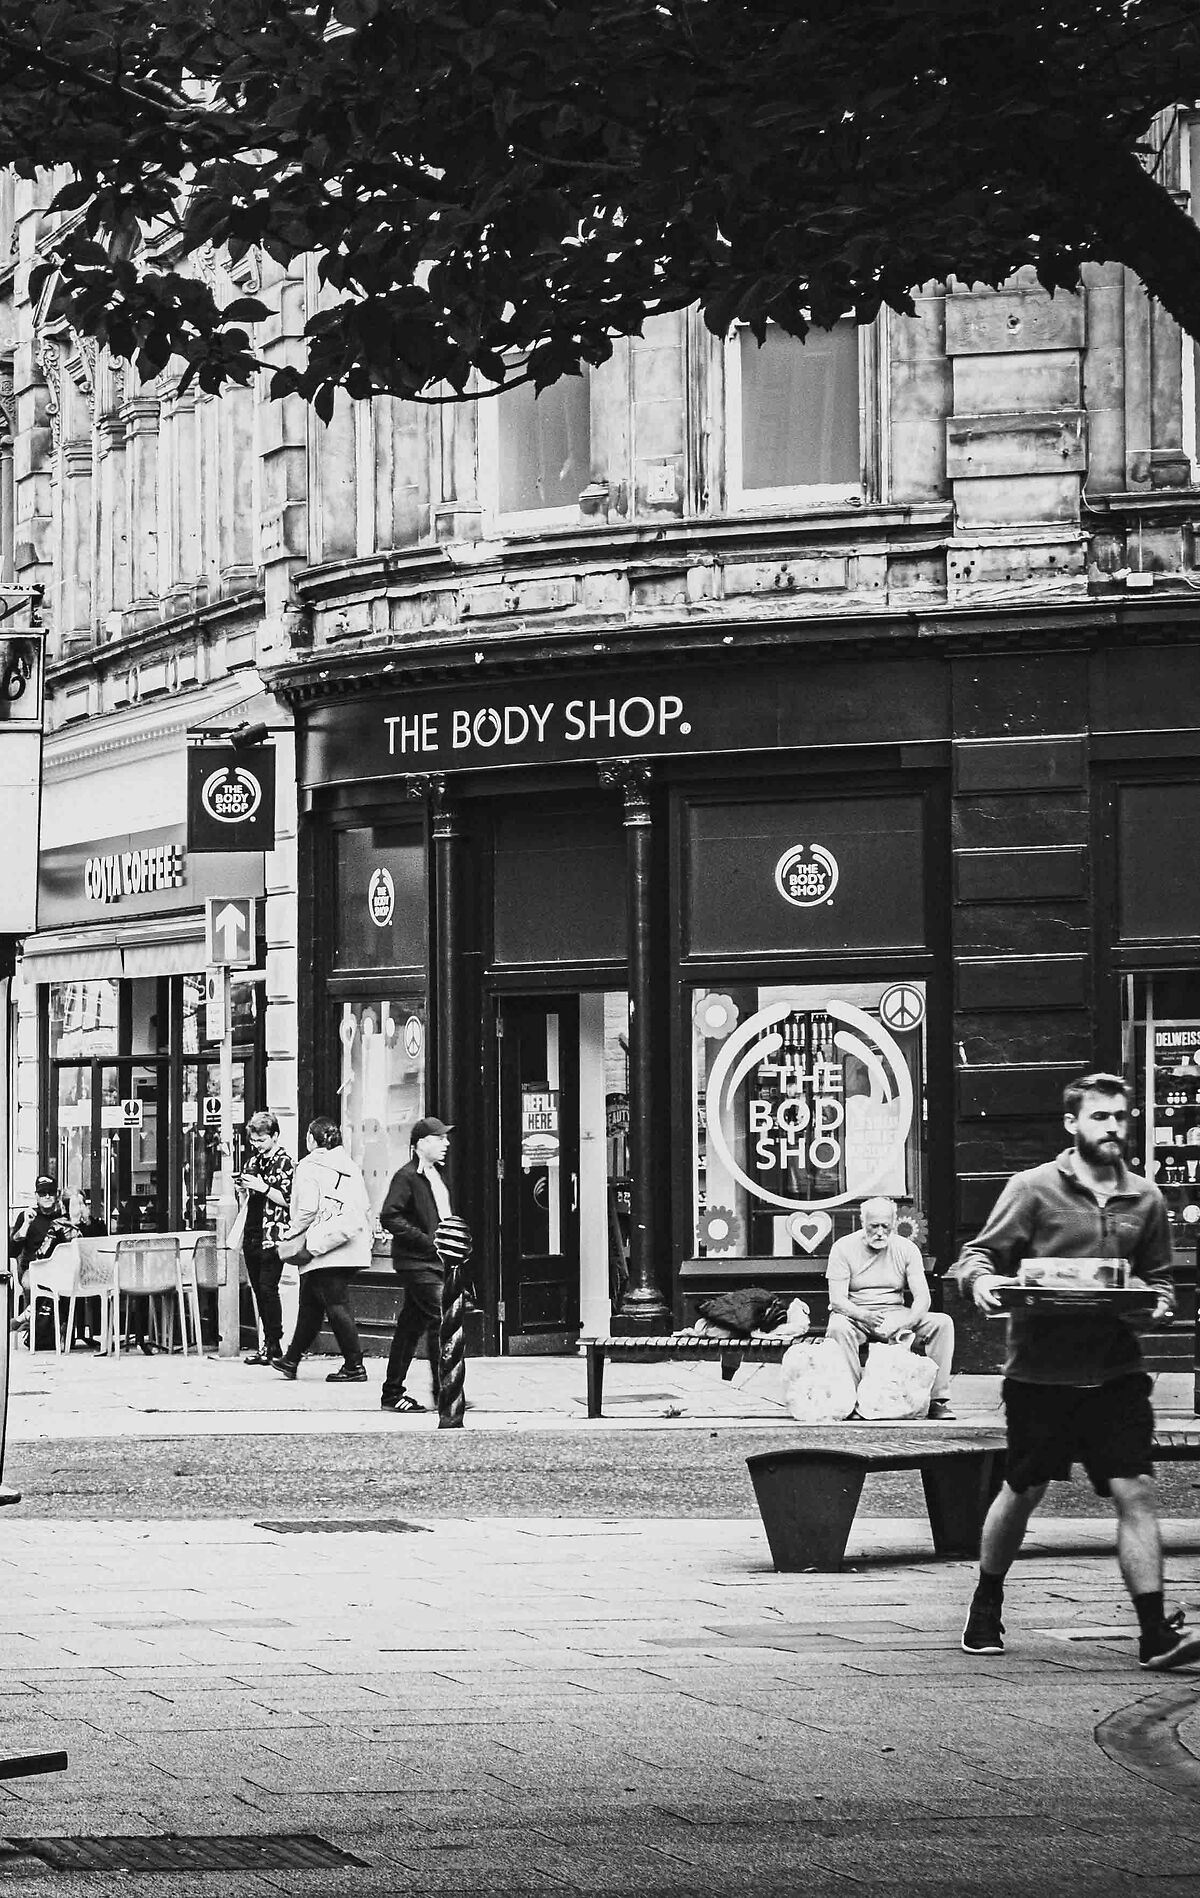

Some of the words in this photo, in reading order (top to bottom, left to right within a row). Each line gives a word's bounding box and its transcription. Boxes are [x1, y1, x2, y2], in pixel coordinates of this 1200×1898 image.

[384, 713, 439, 755] THE
[452, 703, 554, 749] BODY
[222, 785, 243, 794] THE
[215, 793, 249, 804] BODY
[215, 803, 249, 813] SHOP
[84, 853, 121, 904] COSTA
[121, 844, 184, 895] COFFEE
[796, 864, 819, 874] THE
[789, 873, 826, 885] BODY
[790, 884, 826, 896] SHOP
[773, 1063, 844, 1094] THE
[528, 1112, 553, 1130] HERE
[749, 1099, 845, 1133] BOD
[756, 1136, 842, 1169] SHO
